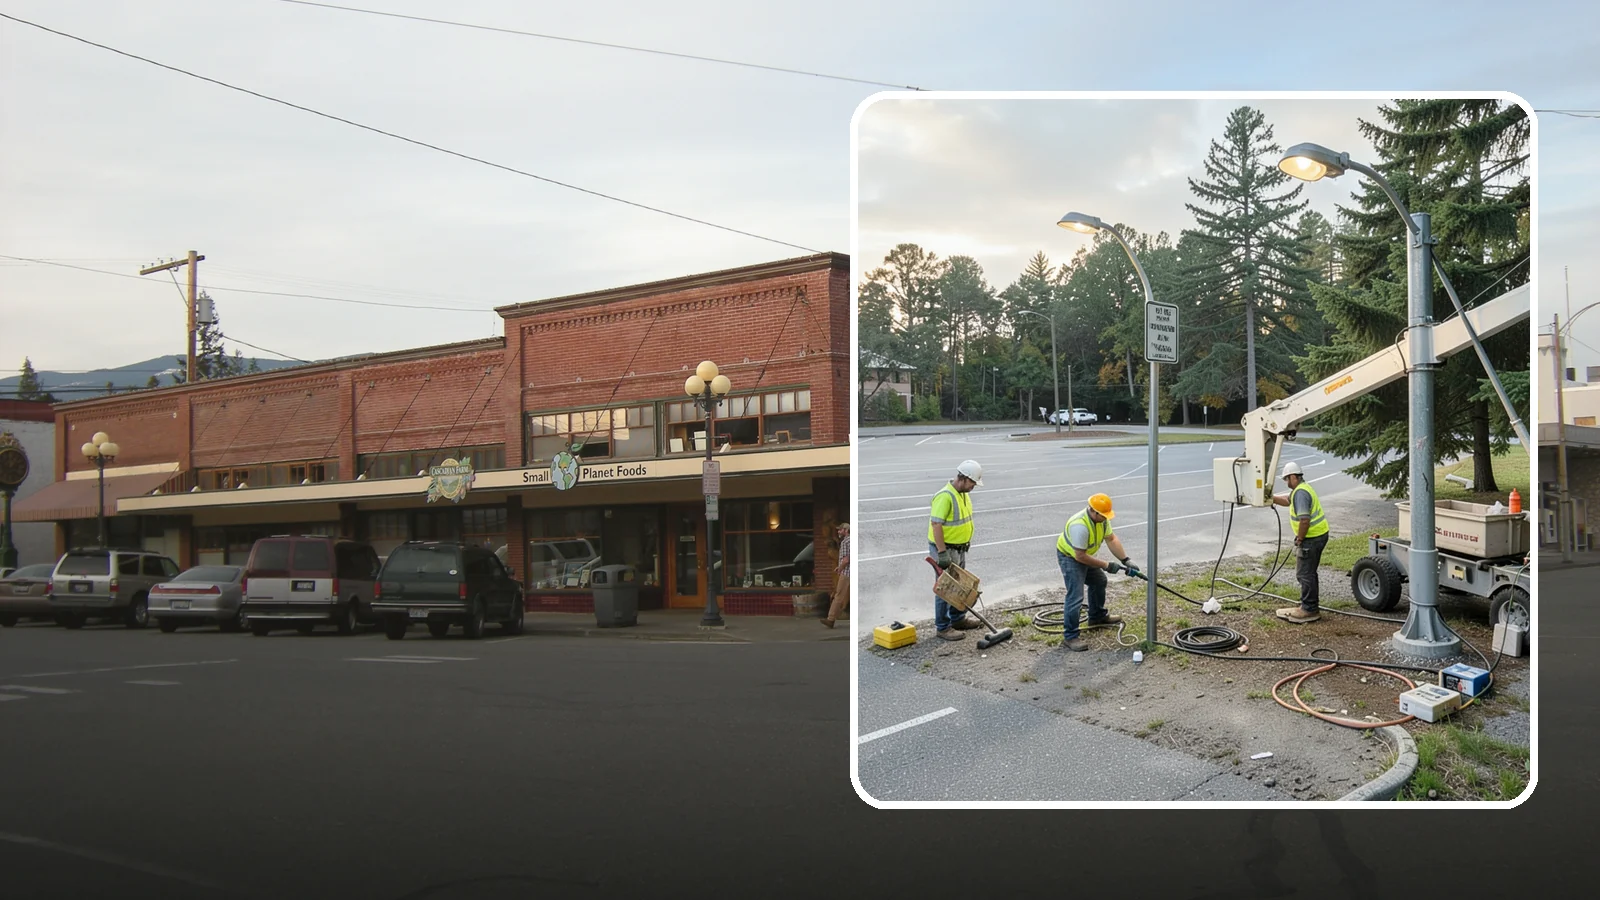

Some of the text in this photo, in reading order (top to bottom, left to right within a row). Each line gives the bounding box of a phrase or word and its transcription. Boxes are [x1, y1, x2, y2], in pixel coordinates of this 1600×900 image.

[431, 465, 457, 476] CASCADIAN
[523, 464, 647, 483] Small Planet Foods
